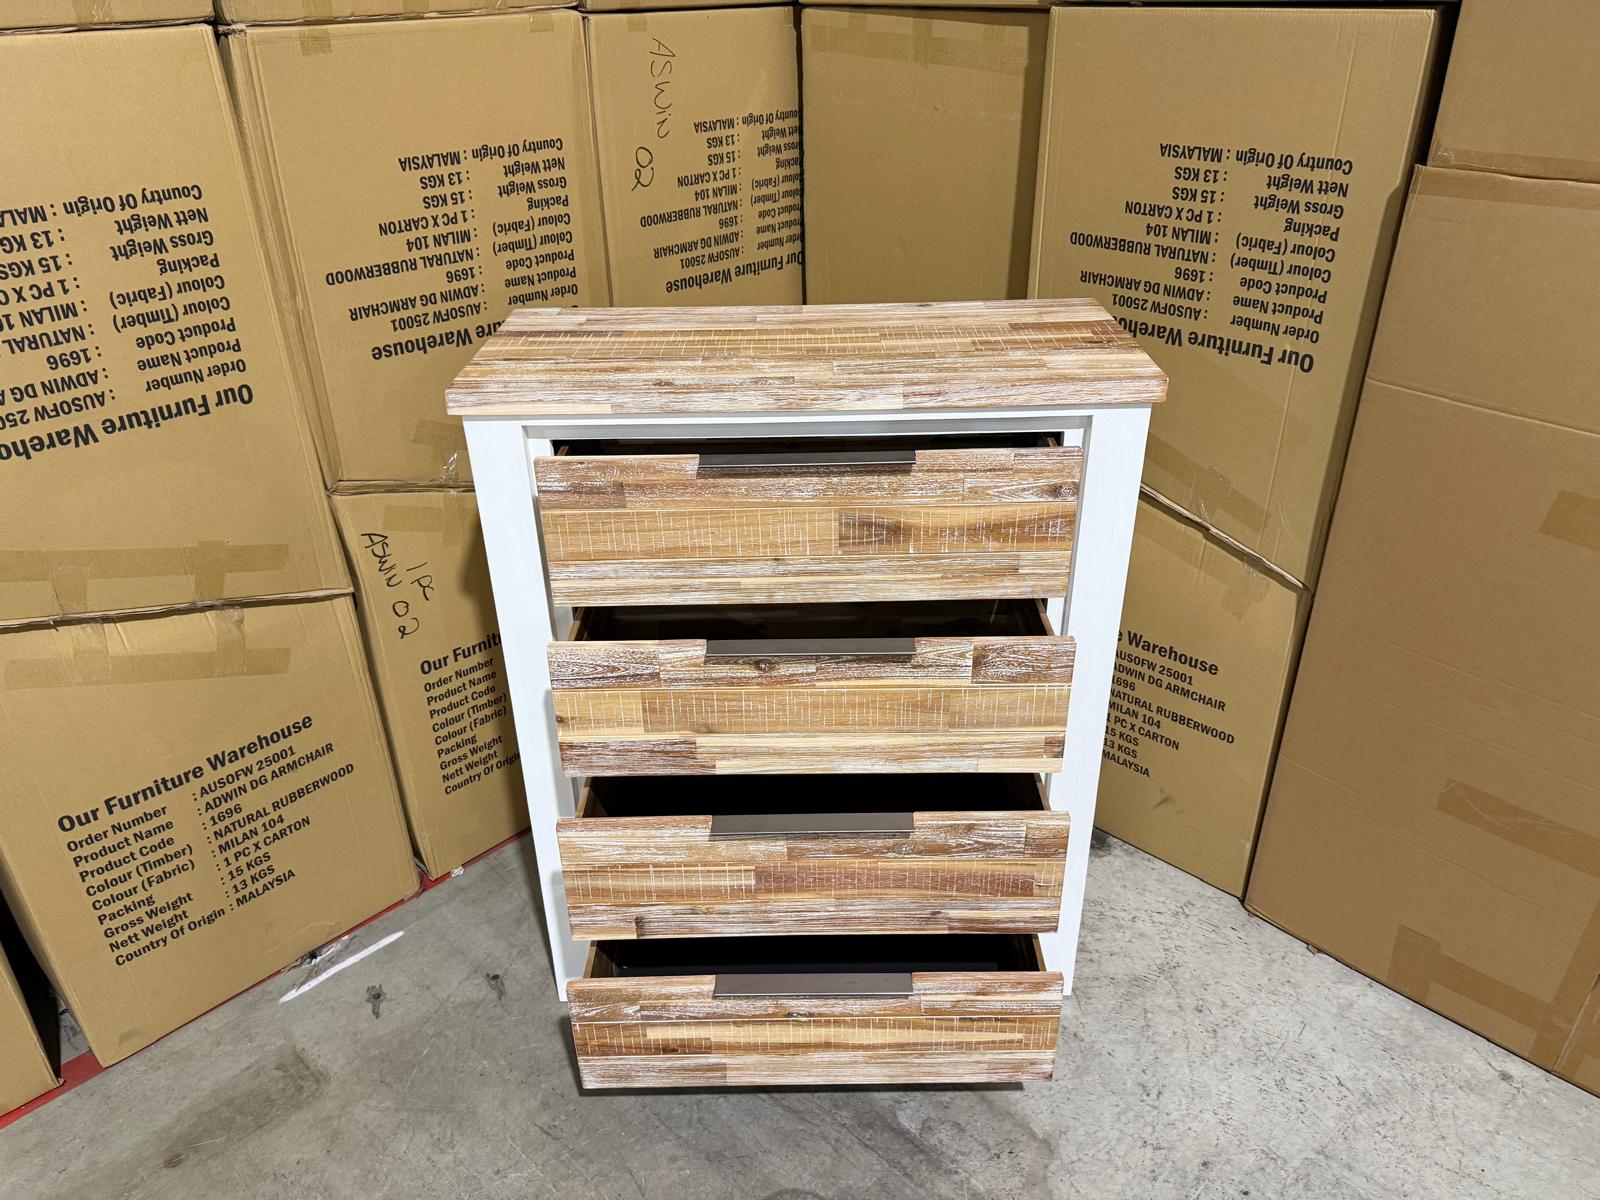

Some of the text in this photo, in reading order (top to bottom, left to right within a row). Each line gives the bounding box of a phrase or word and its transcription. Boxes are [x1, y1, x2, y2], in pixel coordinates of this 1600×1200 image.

[397, 137, 563, 172] Country Of Origin MALAYSIA
[631, 146, 654, 192] 02
[1159, 143, 1353, 176] Country Of Origin MALAYSIA
[694, 188, 710, 202] 104
[712, 183, 737, 198] MILAN
[750, 189, 780, 207] (Timber)
[751, 174, 780, 191] (Fabric)
[1174, 166, 1349, 198] Nett Weight 13 KGS
[173, 207, 208, 226] Nett
[378, 194, 569, 236] Packing 1 PC X CARTON
[640, 206, 701, 227] RUBBERWOOD
[702, 199, 738, 216] NATURAL
[1124, 200, 1340, 242] Packing 1 PC X CARTON
[1172, 186, 1344, 219] Gross Weight 15 KGS
[29, 230, 54, 249] 13
[113, 212, 174, 235] Weight
[405, 212, 571, 252] Colour (Fabric) MILAN 104
[1145, 222, 1335, 263] Colour (Fabric) MILAN 104
[734, 255, 783, 277] Furniture
[1070, 231, 1331, 283] Colour (Timber) NATURAL RUBBERWOOD
[10, 252, 220, 303] Packing 1 PC X
[348, 266, 576, 321] Product Name ADWIN DG ARMCHAIR
[665, 267, 732, 293] Warehouse
[1079, 270, 1324, 324] Product Name ADWIN DG ARMCHAIR
[1174, 266, 1328, 304] Product Code 1696
[390, 283, 578, 332] Order Number AUSOFW 25001
[1112, 293, 1320, 344] Order Number AUSOFW 25001
[46, 316, 236, 370] Product Code 1696
[371, 327, 473, 360] Warehouse
[1113, 316, 1314, 373] Our Furniture Wareho
[101, 394, 211, 434] Furniture
[215, 383, 253, 407] Our
[392, 600, 420, 640] 02
[421, 655, 449, 675] Our
[1127, 630, 1219, 675] Warehouse
[423, 657, 494, 692] Order Number
[426, 671, 496, 706] Product Name
[432, 692, 507, 732] Colour (Timber)
[1141, 713, 1161, 730] 104
[1155, 705, 1235, 744] RUBBERWOOD
[436, 733, 477, 759] Packing
[1113, 715, 1128, 729] PC
[1128, 721, 1136, 733] X
[1137, 726, 1179, 750] CARTON
[57, 715, 312, 832] Our Furniture Warehouse
[66, 745, 296, 852] Order Number AUSOFW 25001
[72, 742, 334, 867] Product Name ADWIN DG ARMCHAIR
[78, 803, 242, 883] Product Code 1696
[85, 763, 354, 896] Colour (Timber) NATURAL RUBBERWOOD
[91, 814, 284, 911] Colour (Fabric) MILAN 104
[97, 815, 310, 926] Packing 1 PC X CARTON
[103, 851, 271, 938] Gross Weight 15 KGS
[108, 864, 275, 952] Nett Weight 13 KGS
[115, 869, 296, 966] Country Of Origin MALAYSIA
